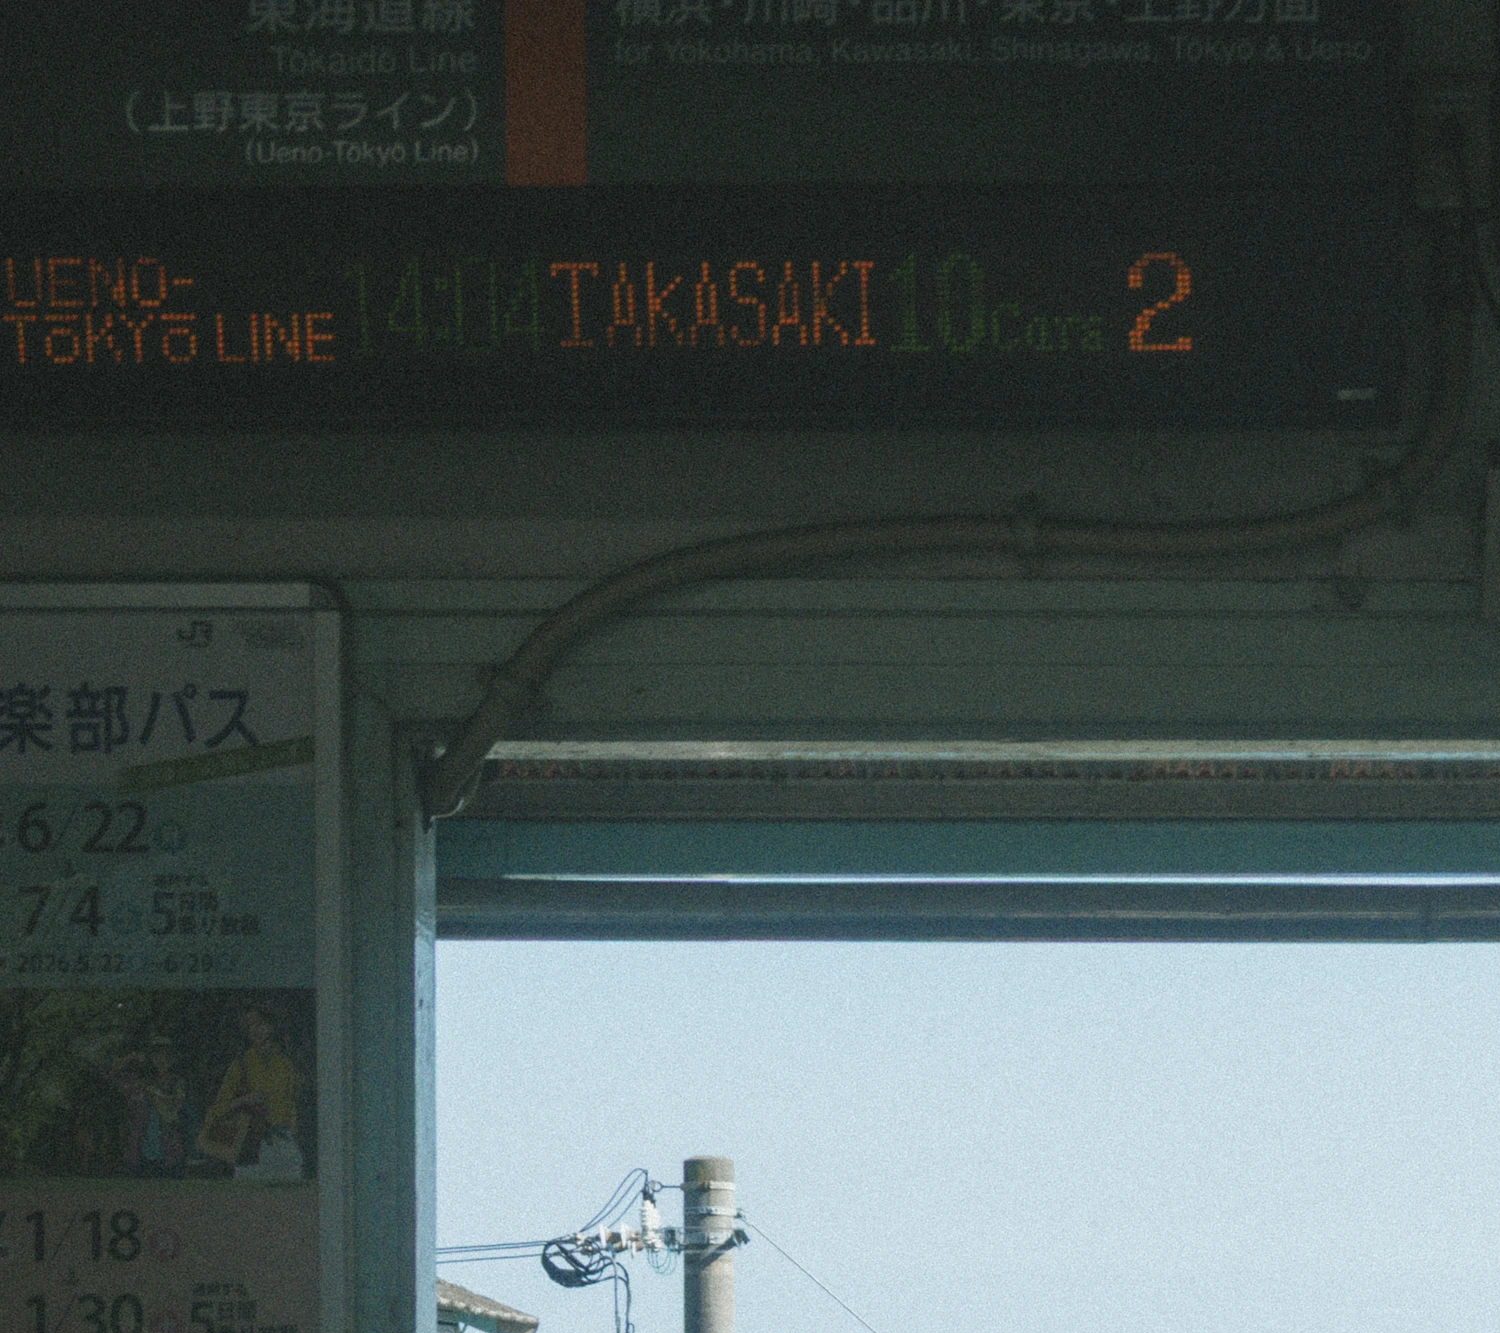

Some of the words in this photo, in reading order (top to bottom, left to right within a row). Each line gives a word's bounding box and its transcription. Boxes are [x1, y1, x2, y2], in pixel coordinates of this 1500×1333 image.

[408, 44, 478, 74] Line
[413, 137, 480, 166] Line)
[6, 257, 195, 308] UENO-
[548, 260, 876, 350] TAKASAKI
[1127, 252, 1193, 352] 2
[215, 312, 336, 364] LINE
[0, 682, 259, 755] 楽部パス
[17, 801, 151, 854] 6/22
[26, 1209, 142, 1262] 1/18
